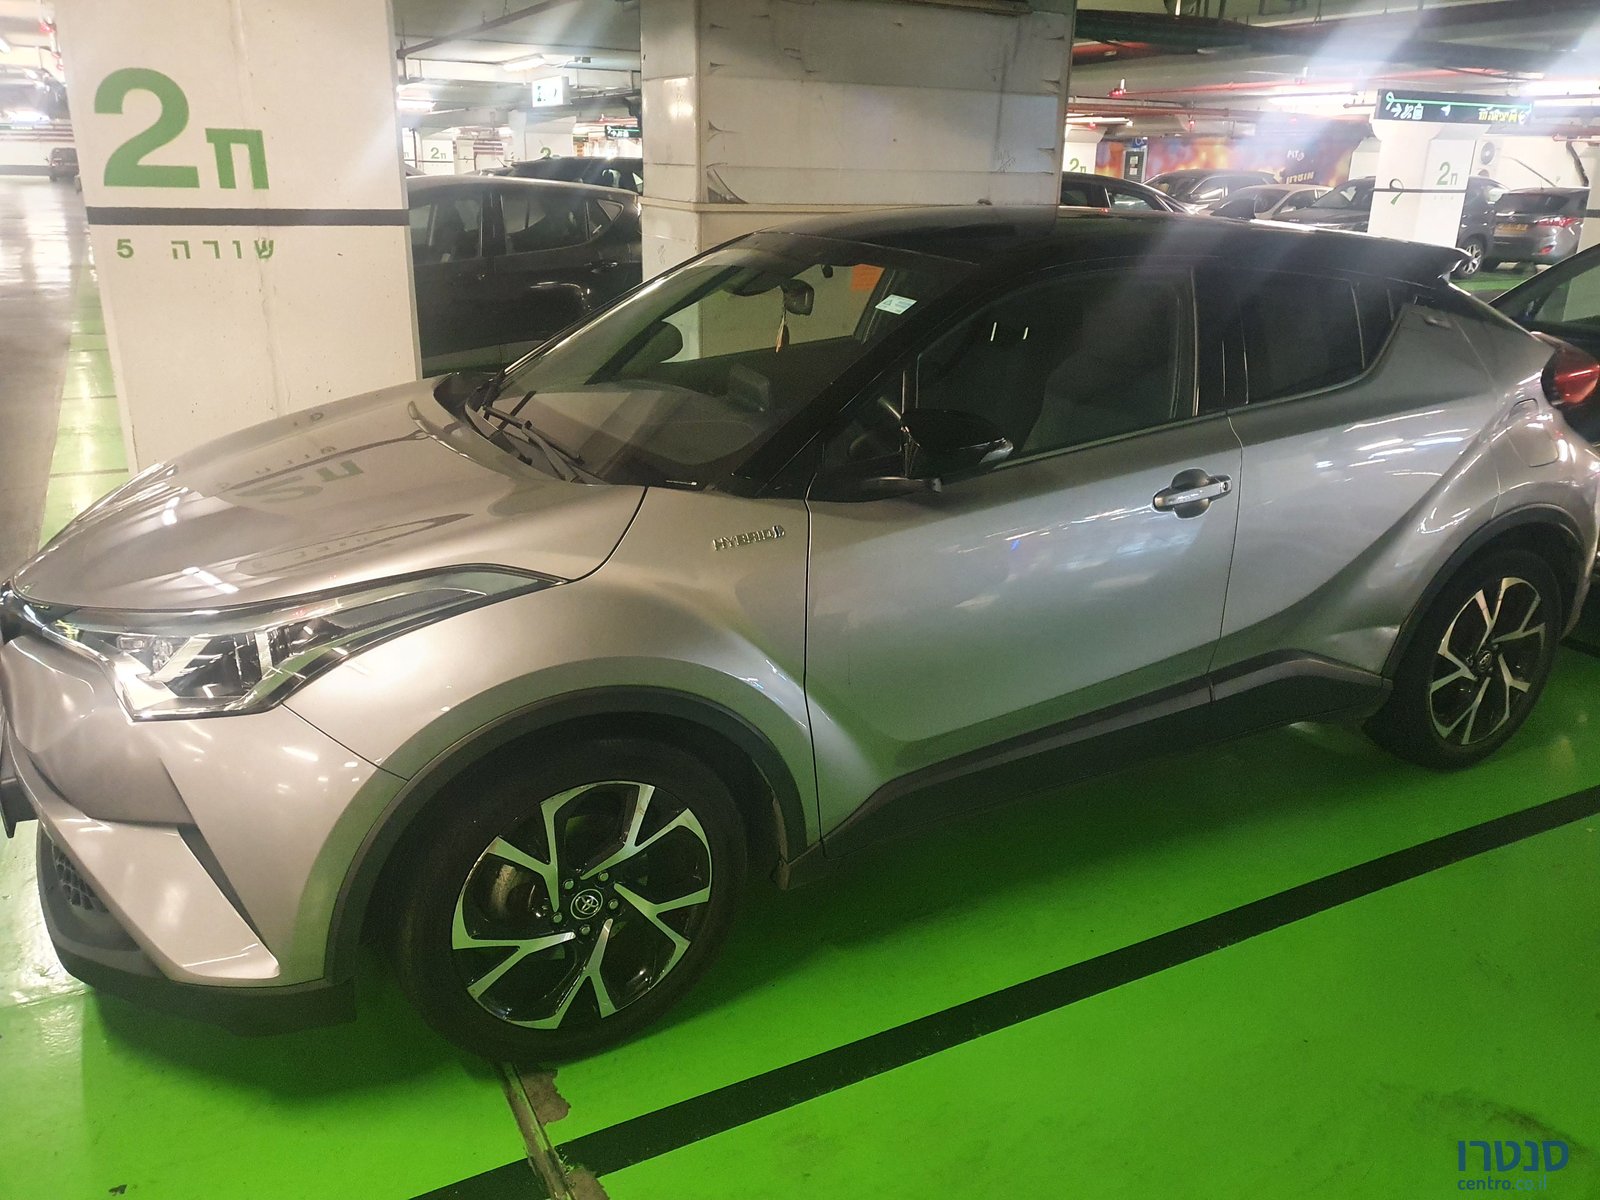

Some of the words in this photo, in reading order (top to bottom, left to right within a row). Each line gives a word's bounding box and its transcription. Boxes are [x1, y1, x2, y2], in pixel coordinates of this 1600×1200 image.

[116, 238, 134, 259] 5
[171, 238, 275, 260] שורה
[711, 529, 774, 551] HYBRID
